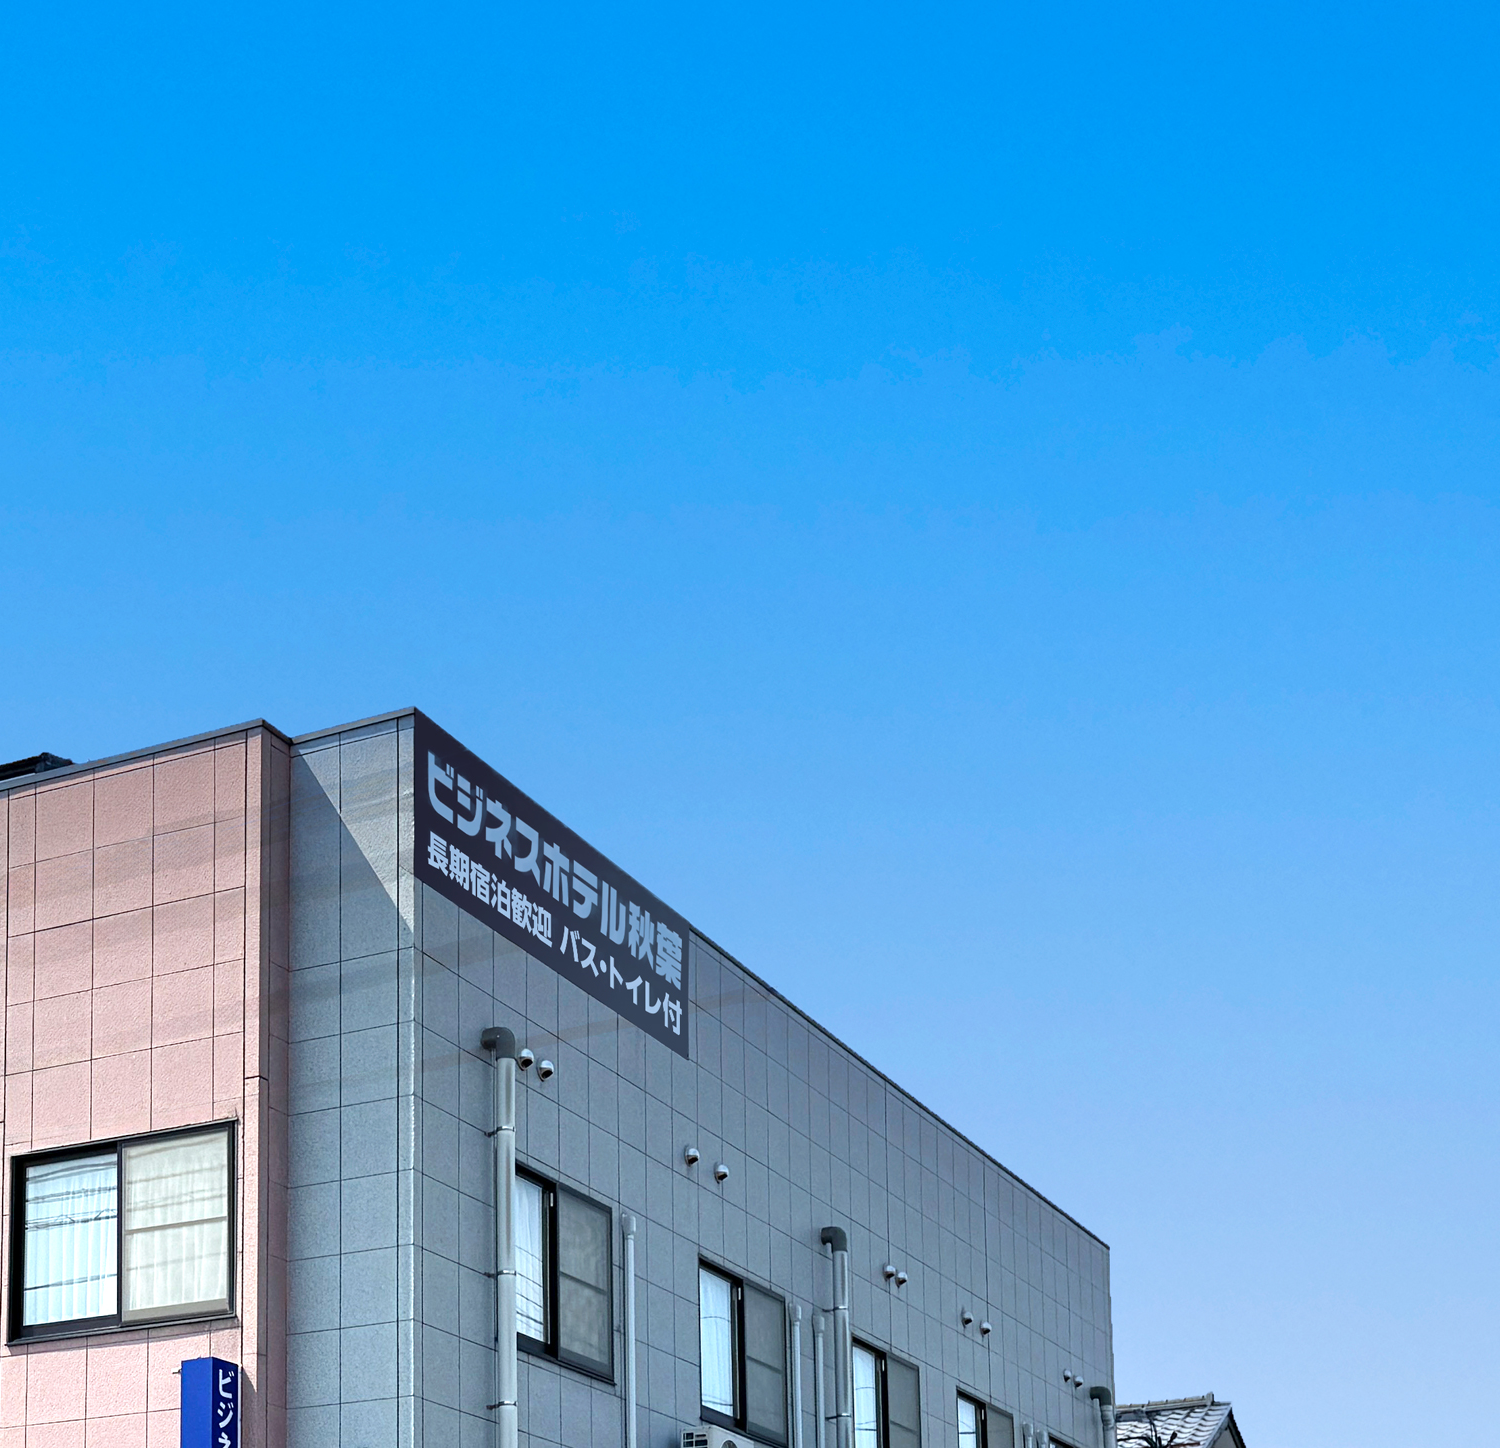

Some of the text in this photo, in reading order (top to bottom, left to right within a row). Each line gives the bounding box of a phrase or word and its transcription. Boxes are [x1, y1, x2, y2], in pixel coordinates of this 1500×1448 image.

[427, 751, 683, 990] ビジネスホテル秋葉
[428, 831, 683, 1035] 長期宿泊歓迎 バス・トイレ付
